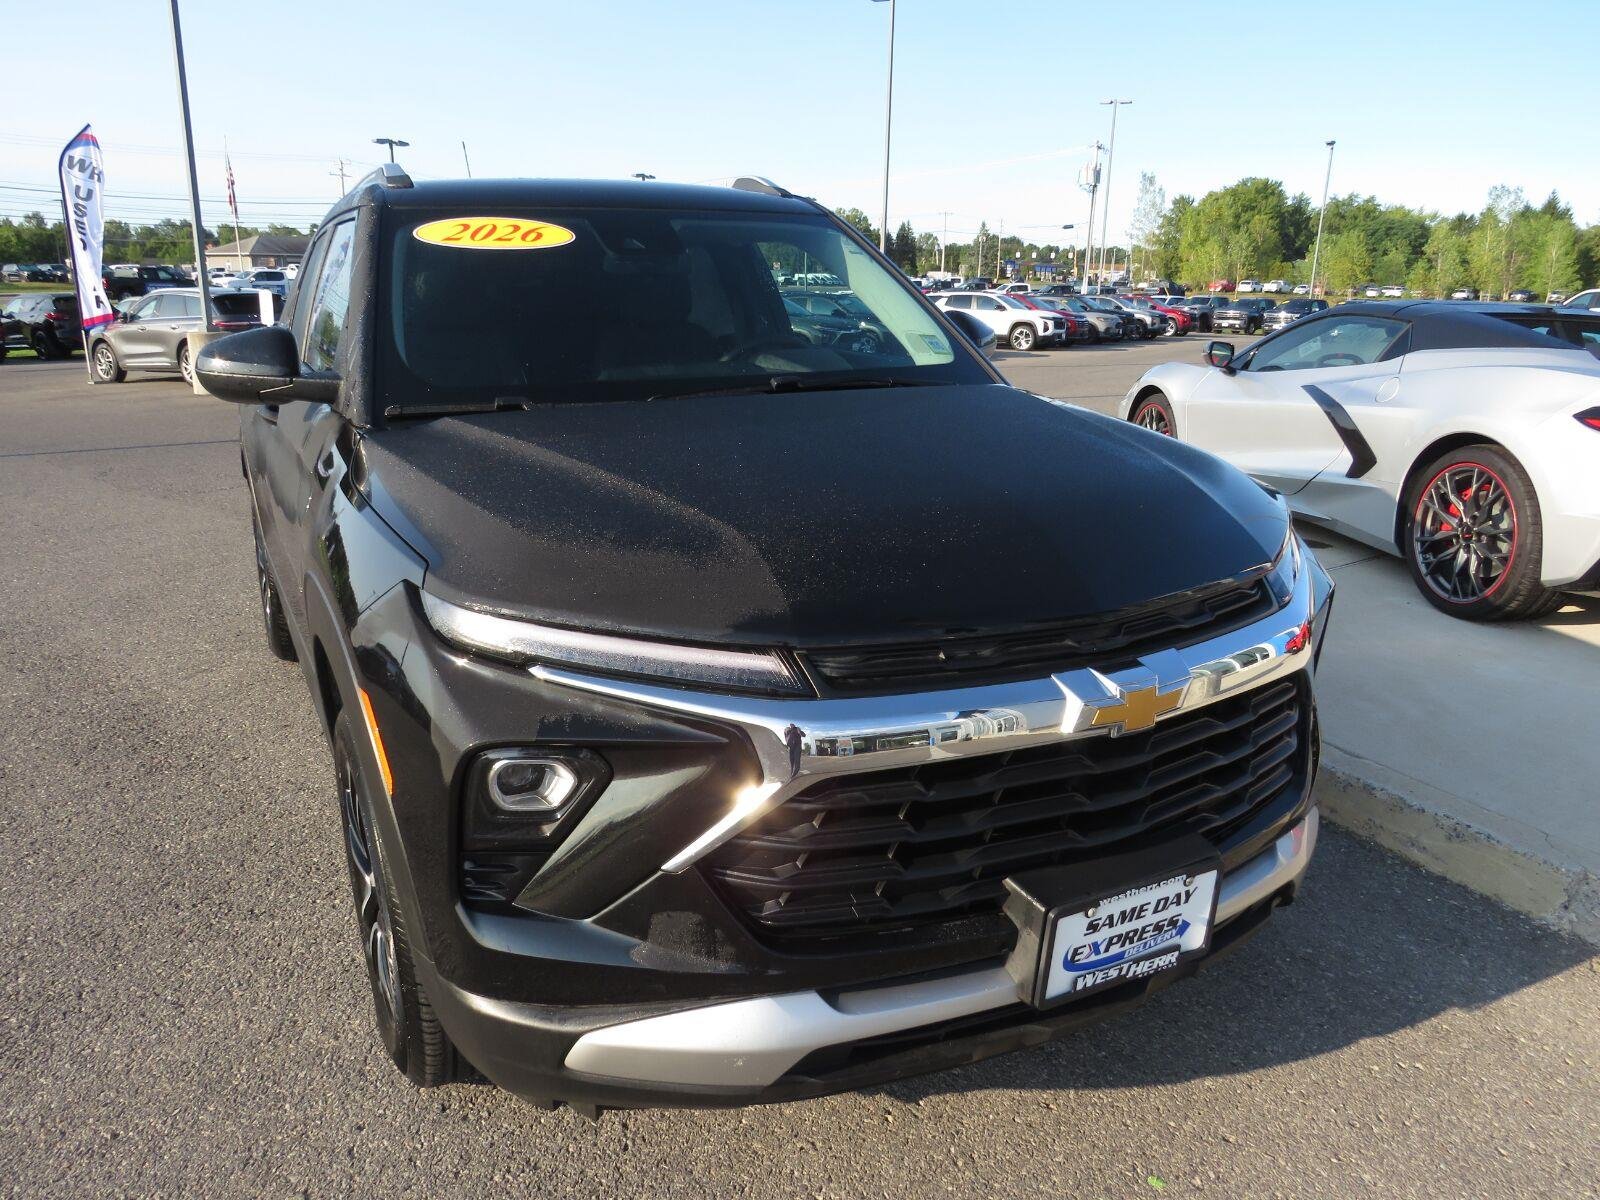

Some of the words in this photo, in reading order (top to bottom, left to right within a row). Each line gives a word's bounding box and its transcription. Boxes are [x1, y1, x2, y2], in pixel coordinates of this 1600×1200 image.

[441, 223, 548, 242] 2026
[1099, 874, 1187, 907] westherr.com
[1084, 901, 1151, 936] SAME
[1151, 886, 1198, 915] DAY
[1069, 913, 1183, 963] EXPRESS
[1124, 928, 1180, 958] DELIVERY
